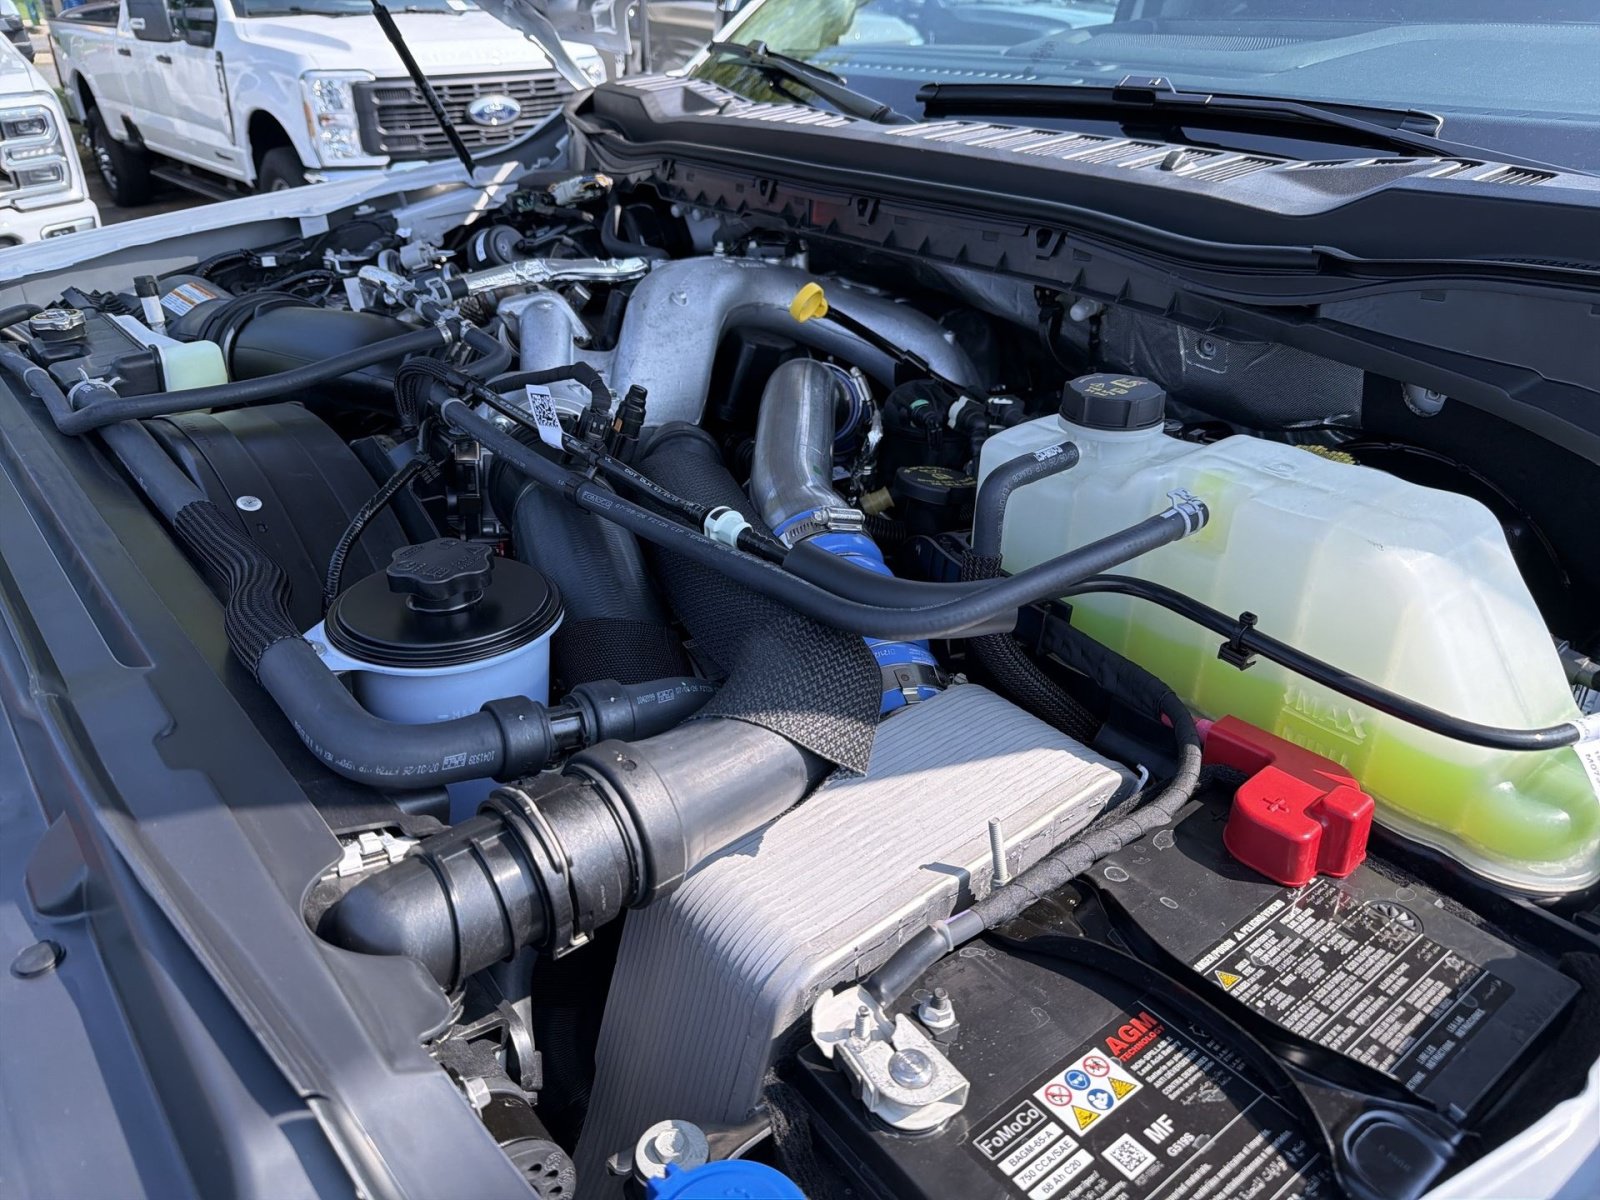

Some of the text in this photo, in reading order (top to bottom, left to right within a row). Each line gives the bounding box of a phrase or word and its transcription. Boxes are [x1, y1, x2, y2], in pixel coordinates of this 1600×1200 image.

[1105, 1011, 1157, 1056] AGM
[1119, 1024, 1165, 1061] TECHNOLOGY
[981, 1104, 1039, 1155] FoMoCo
[1142, 1113, 1180, 1144] MF
[1165, 1132, 1196, 1156] G519S
[1009, 1129, 1053, 1166] BAGM-65-A
[1019, 1139, 1072, 1184] 750 CCA/SAE
[1063, 1158, 1081, 1175] C20
